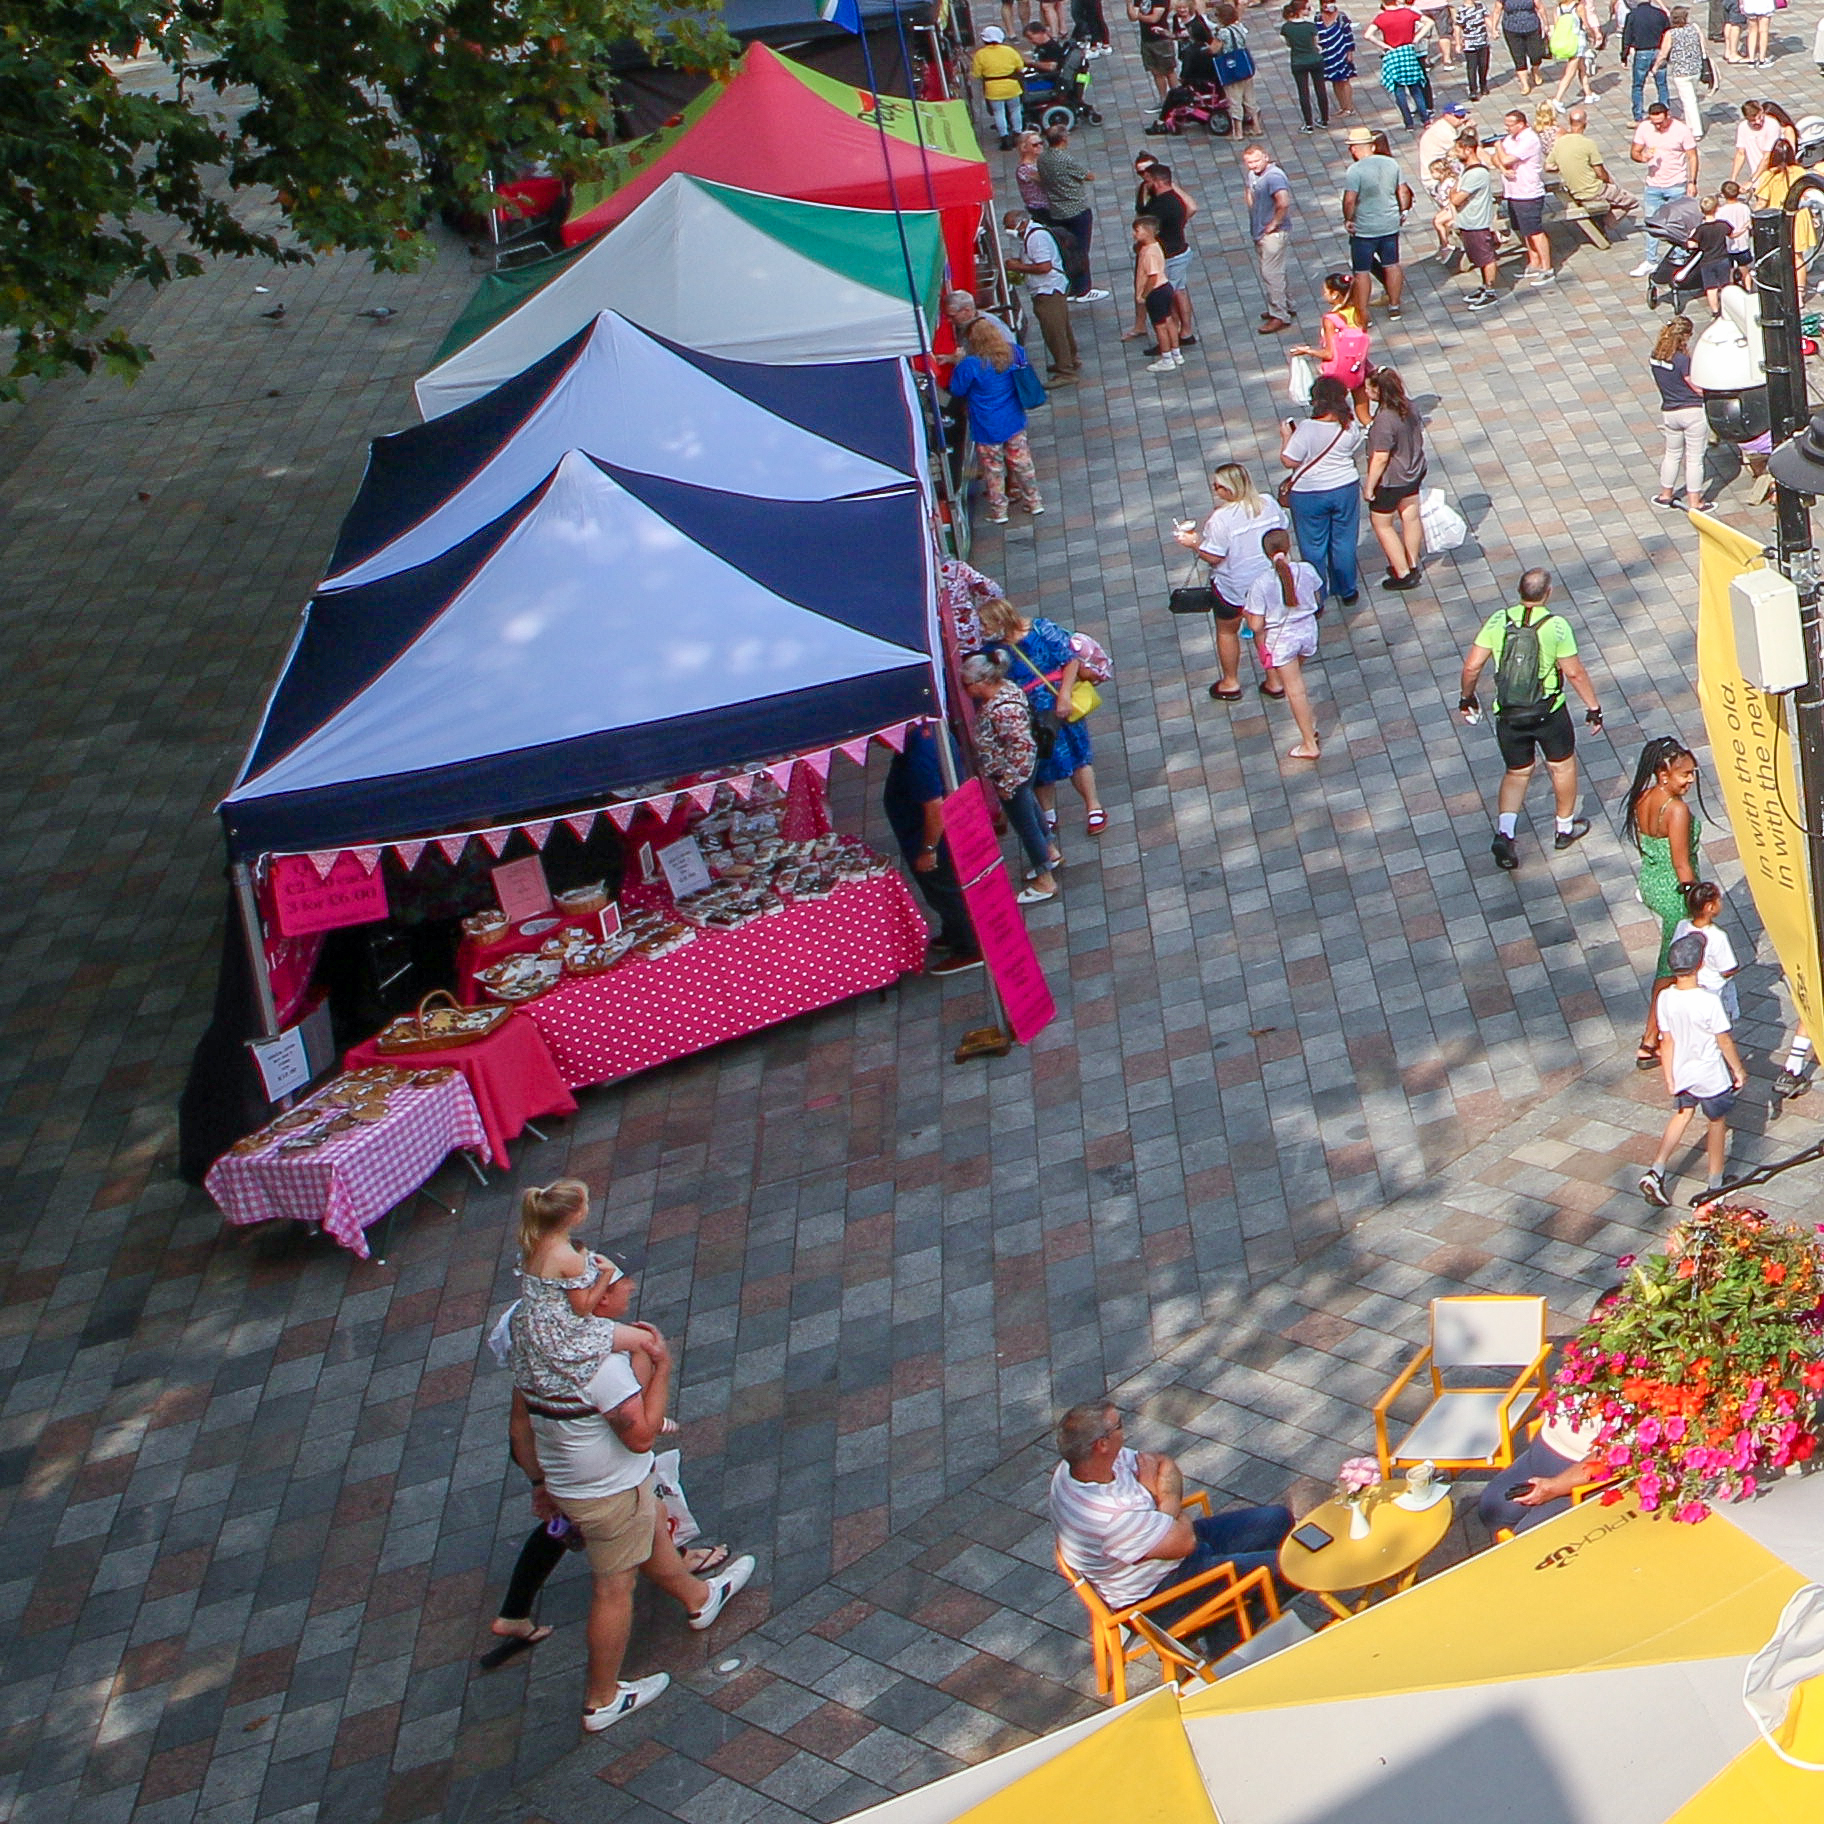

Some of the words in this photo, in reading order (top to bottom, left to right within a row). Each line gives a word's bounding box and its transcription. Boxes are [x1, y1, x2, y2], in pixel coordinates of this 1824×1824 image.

[1721, 681, 1741, 732] old.
[1732, 738, 1753, 784] the
[1756, 745, 1777, 792] the
[1742, 792, 1767, 848] with
[1763, 800, 1788, 857] with
[1760, 855, 1775, 880] In
[1778, 863, 1795, 890] In
